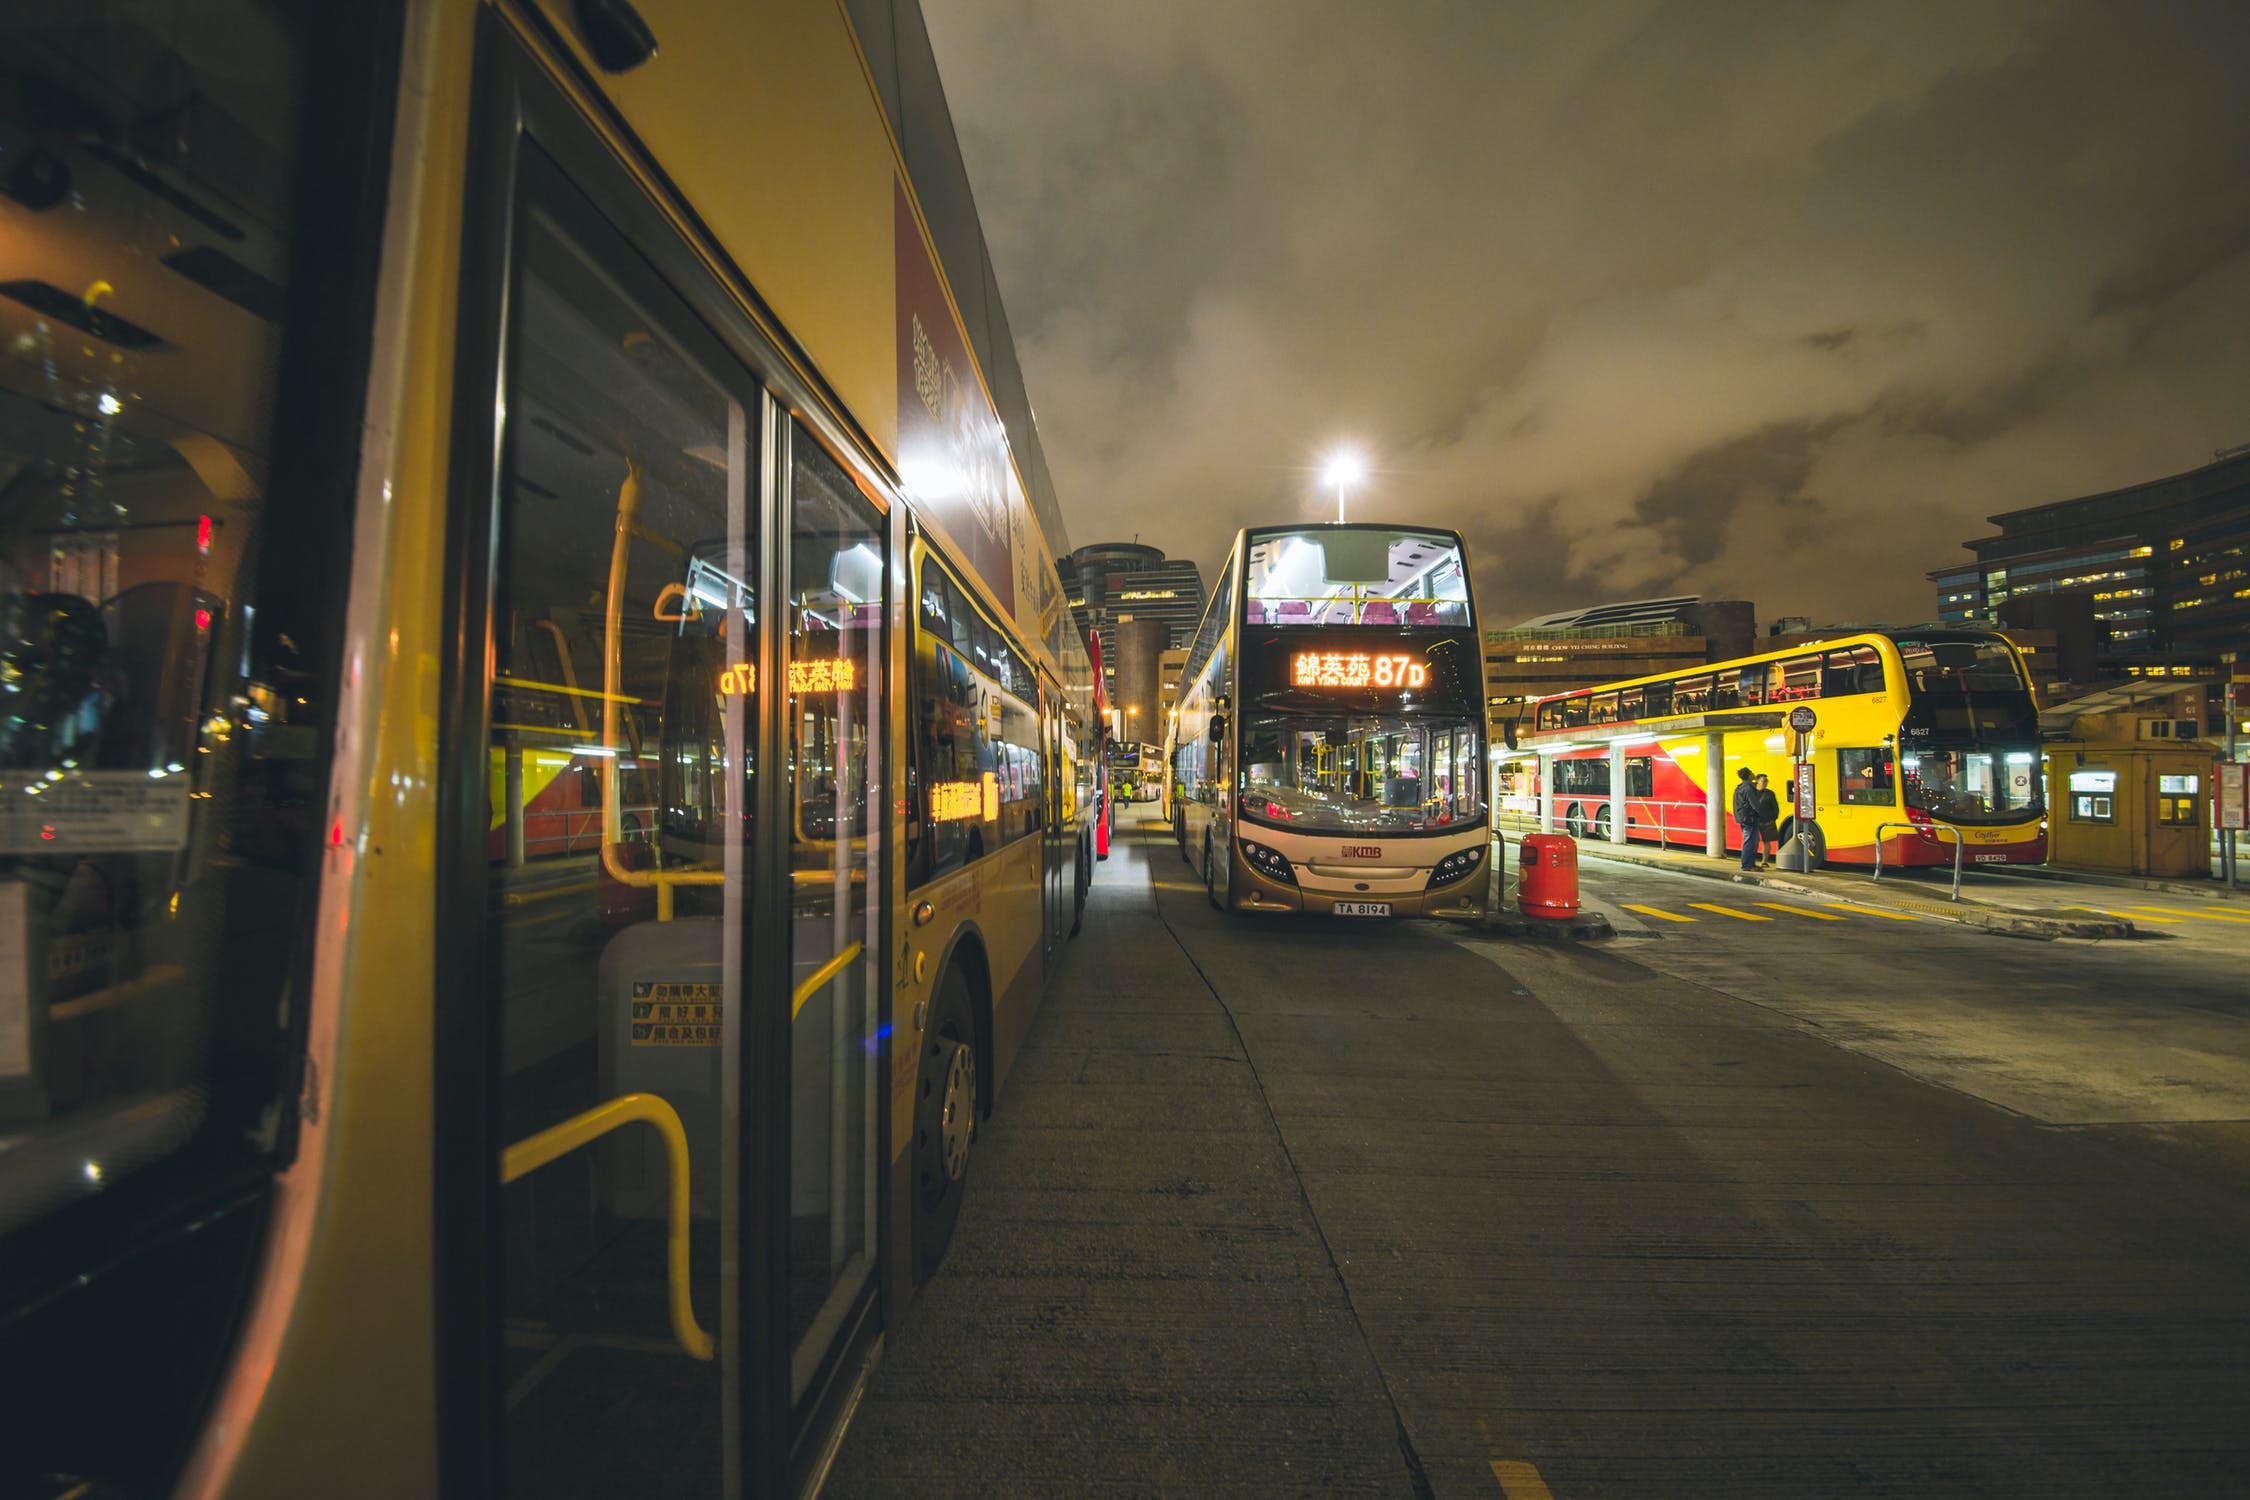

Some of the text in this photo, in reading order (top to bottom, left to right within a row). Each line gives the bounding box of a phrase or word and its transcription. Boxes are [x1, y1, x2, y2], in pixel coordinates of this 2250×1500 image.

[1296, 653, 1370, 677] 錦英苑
[1374, 655, 1425, 686] 87D
[1297, 674, 1368, 686] KAM YING COURT
[1872, 695, 1887, 704] 6827
[1910, 728, 1930, 736] 6827
[1353, 846, 1382, 858] KMB
[1339, 903, 1386, 915] TA 8194
